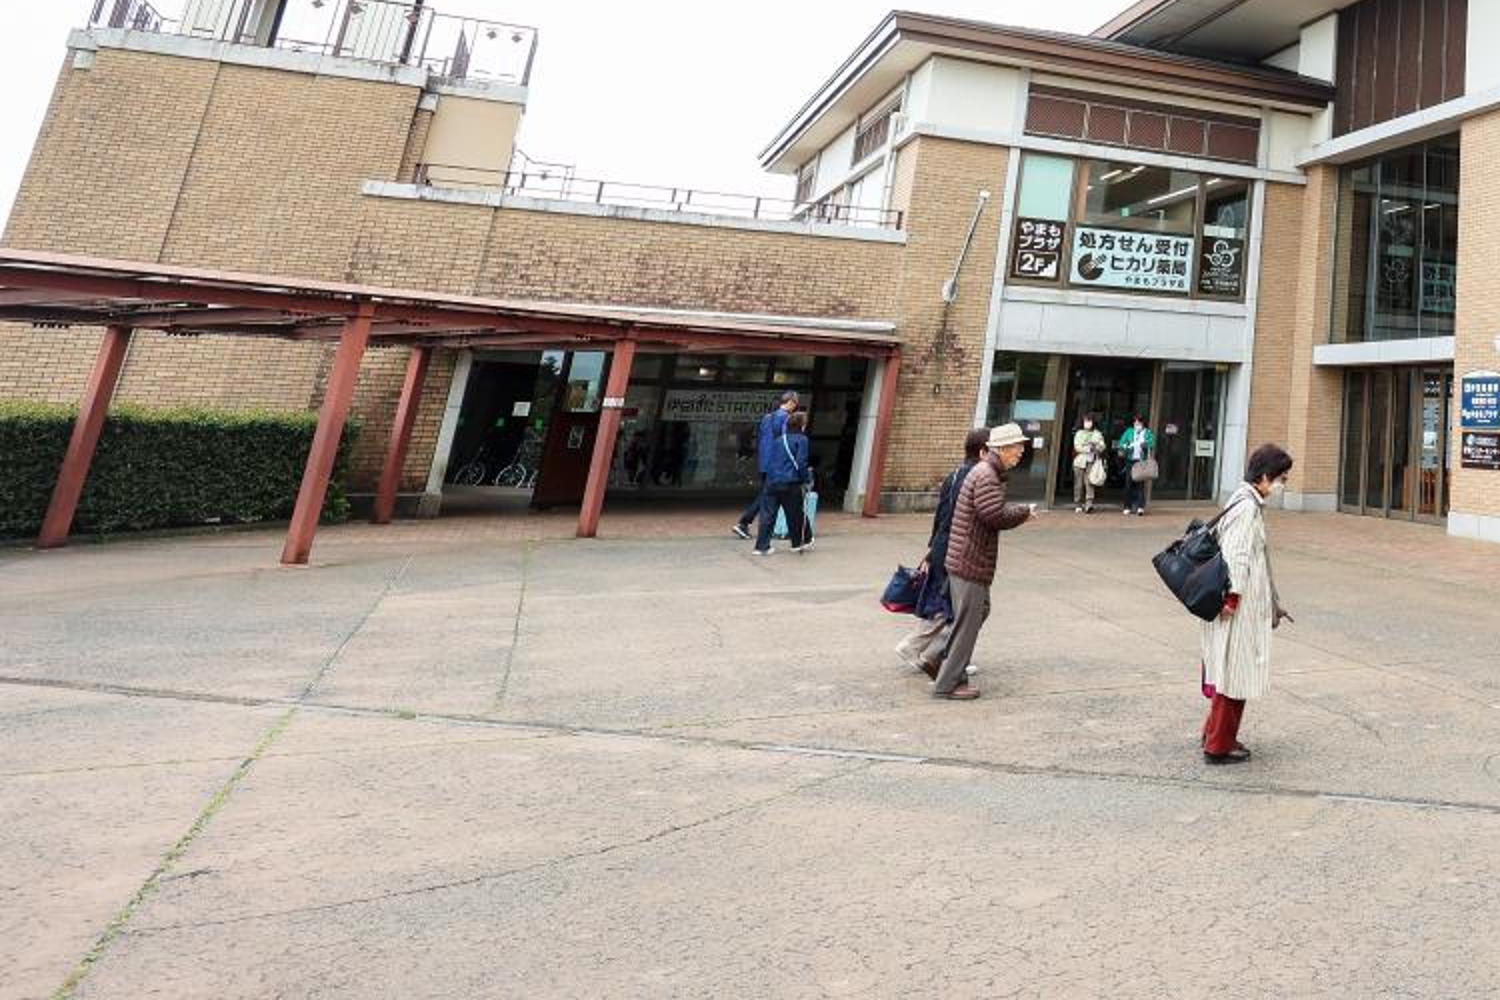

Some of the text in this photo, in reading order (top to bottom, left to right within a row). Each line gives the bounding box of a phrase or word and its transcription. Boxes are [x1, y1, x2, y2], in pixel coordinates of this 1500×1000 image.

[1080, 231, 1189, 257] 処方せん受付
[1020, 253, 1045, 272] 2F
[1110, 254, 1187, 276] ヒカリ薬局
